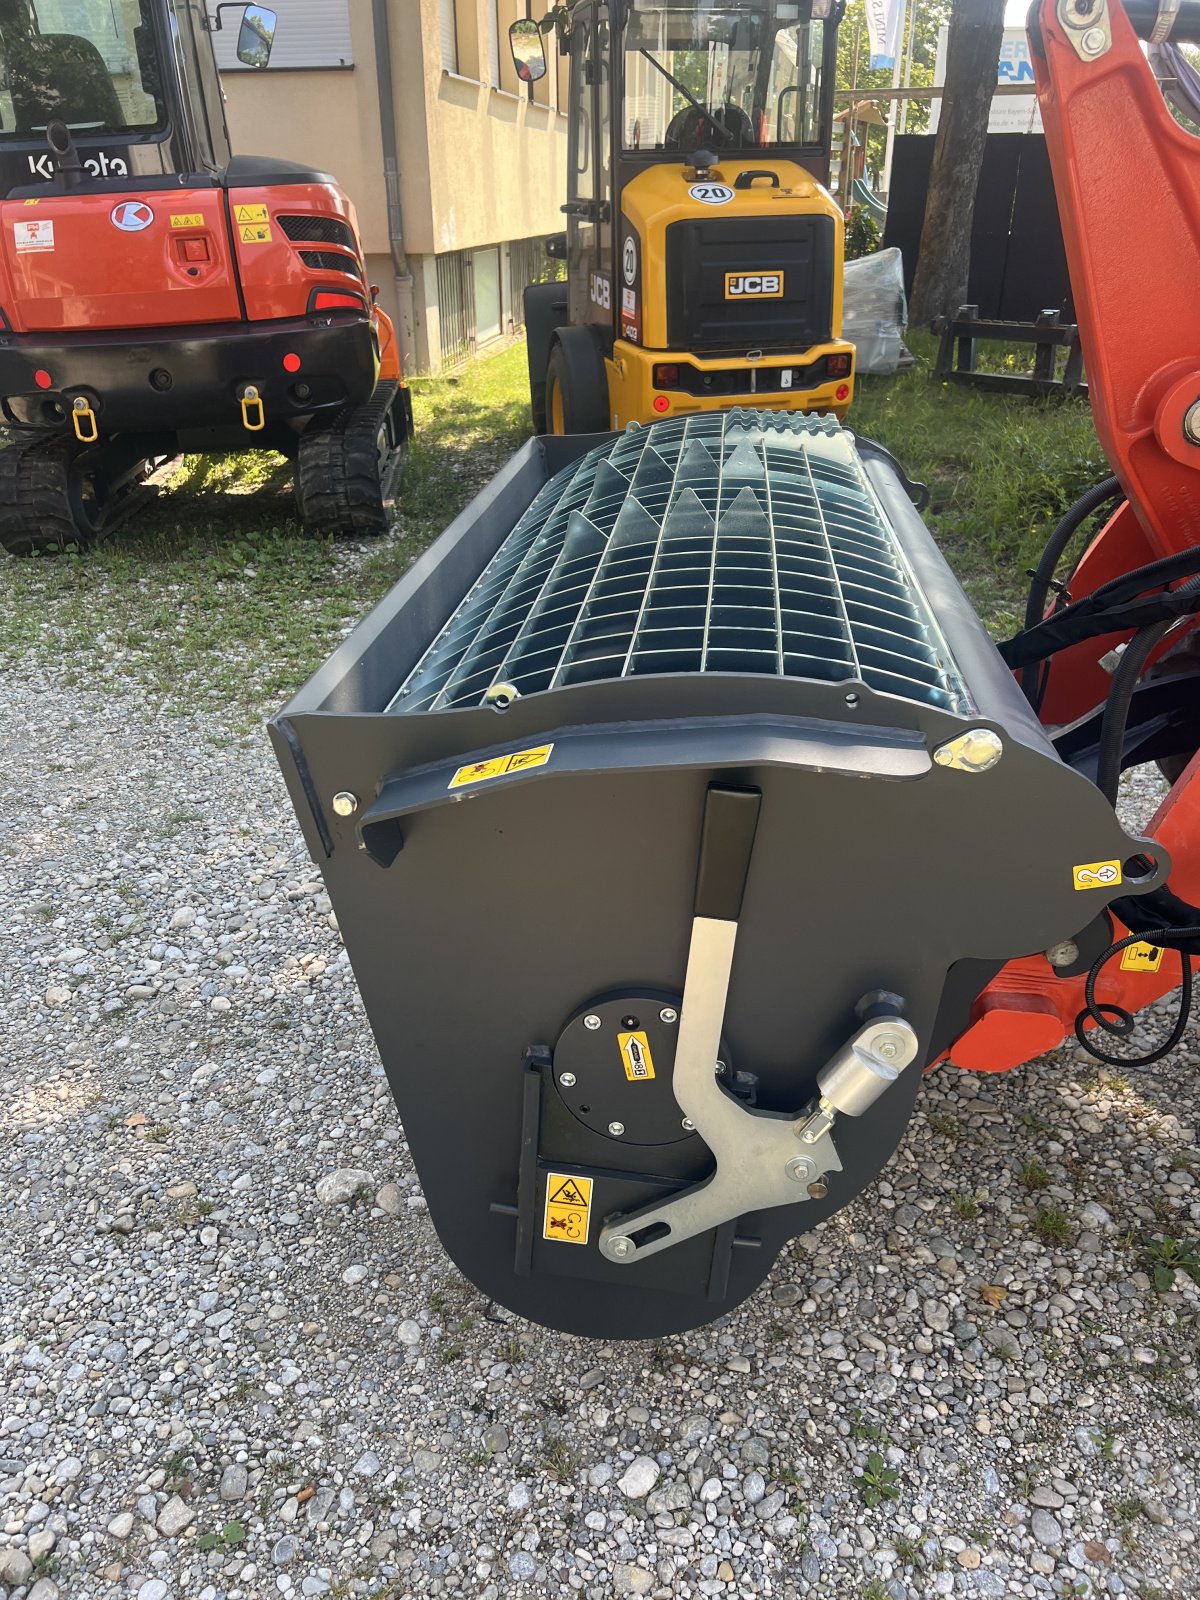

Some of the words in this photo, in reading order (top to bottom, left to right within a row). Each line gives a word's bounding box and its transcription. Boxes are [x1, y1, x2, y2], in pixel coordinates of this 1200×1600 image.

[28, 152, 128, 179] Kota
[697, 188, 726, 199] 20
[625, 248, 634, 274] 20
[590, 273, 610, 310] JCB
[730, 276, 779, 294] JCB
